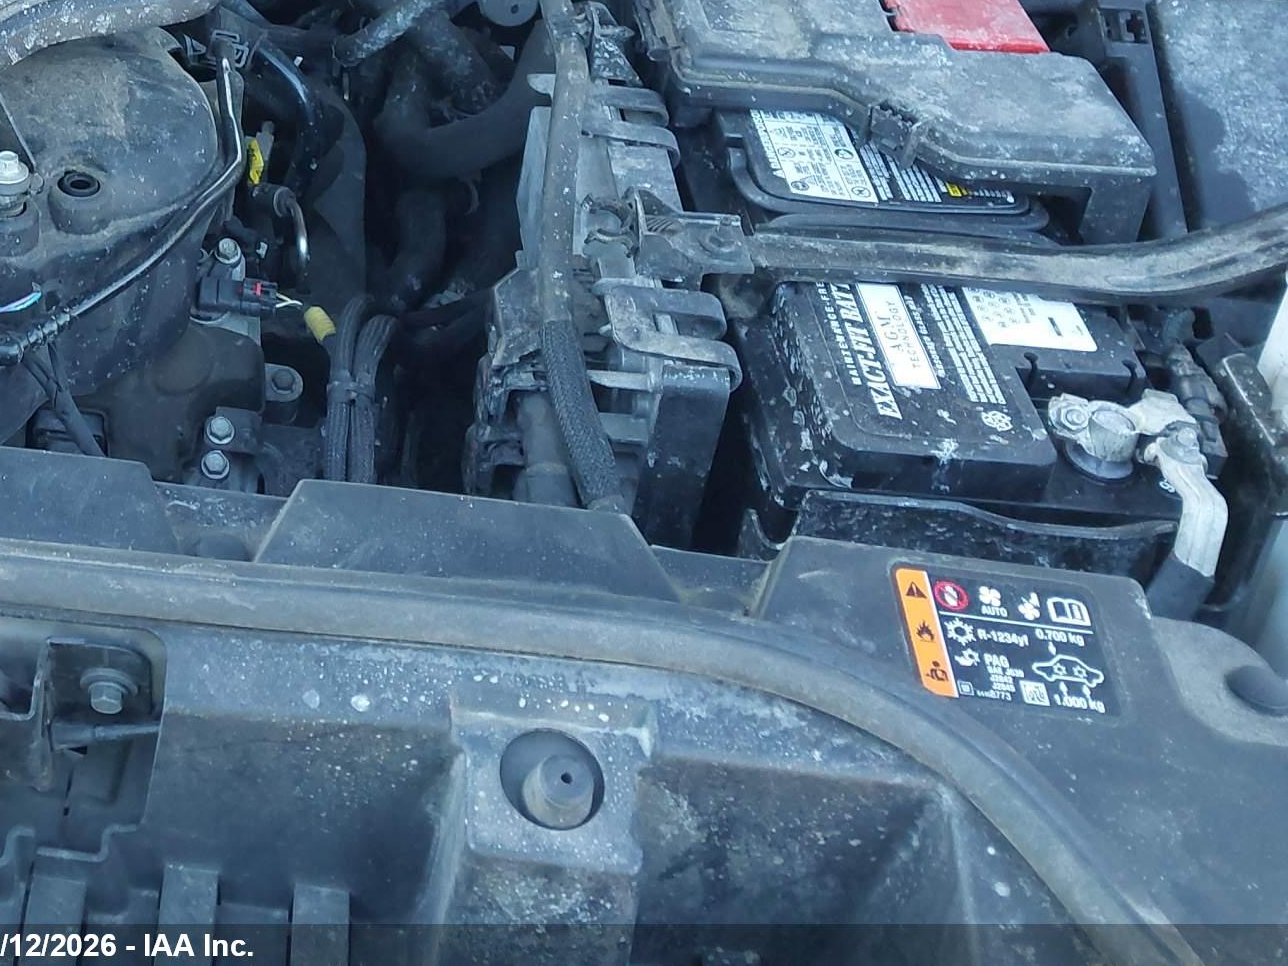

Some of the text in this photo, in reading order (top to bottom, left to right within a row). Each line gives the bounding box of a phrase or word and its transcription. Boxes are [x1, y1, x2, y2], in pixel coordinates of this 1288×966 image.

[877, 315, 905, 351] AGM
[845, 321, 902, 419] EXACT-FIT
[981, 604, 1008, 617] AUTO
[977, 628, 1029, 647] R-1234yf
[1035, 628, 1085, 647] 0.700 kg
[983, 652, 1010, 668] PAG
[1054, 694, 1106, 714] 1.000 kg
